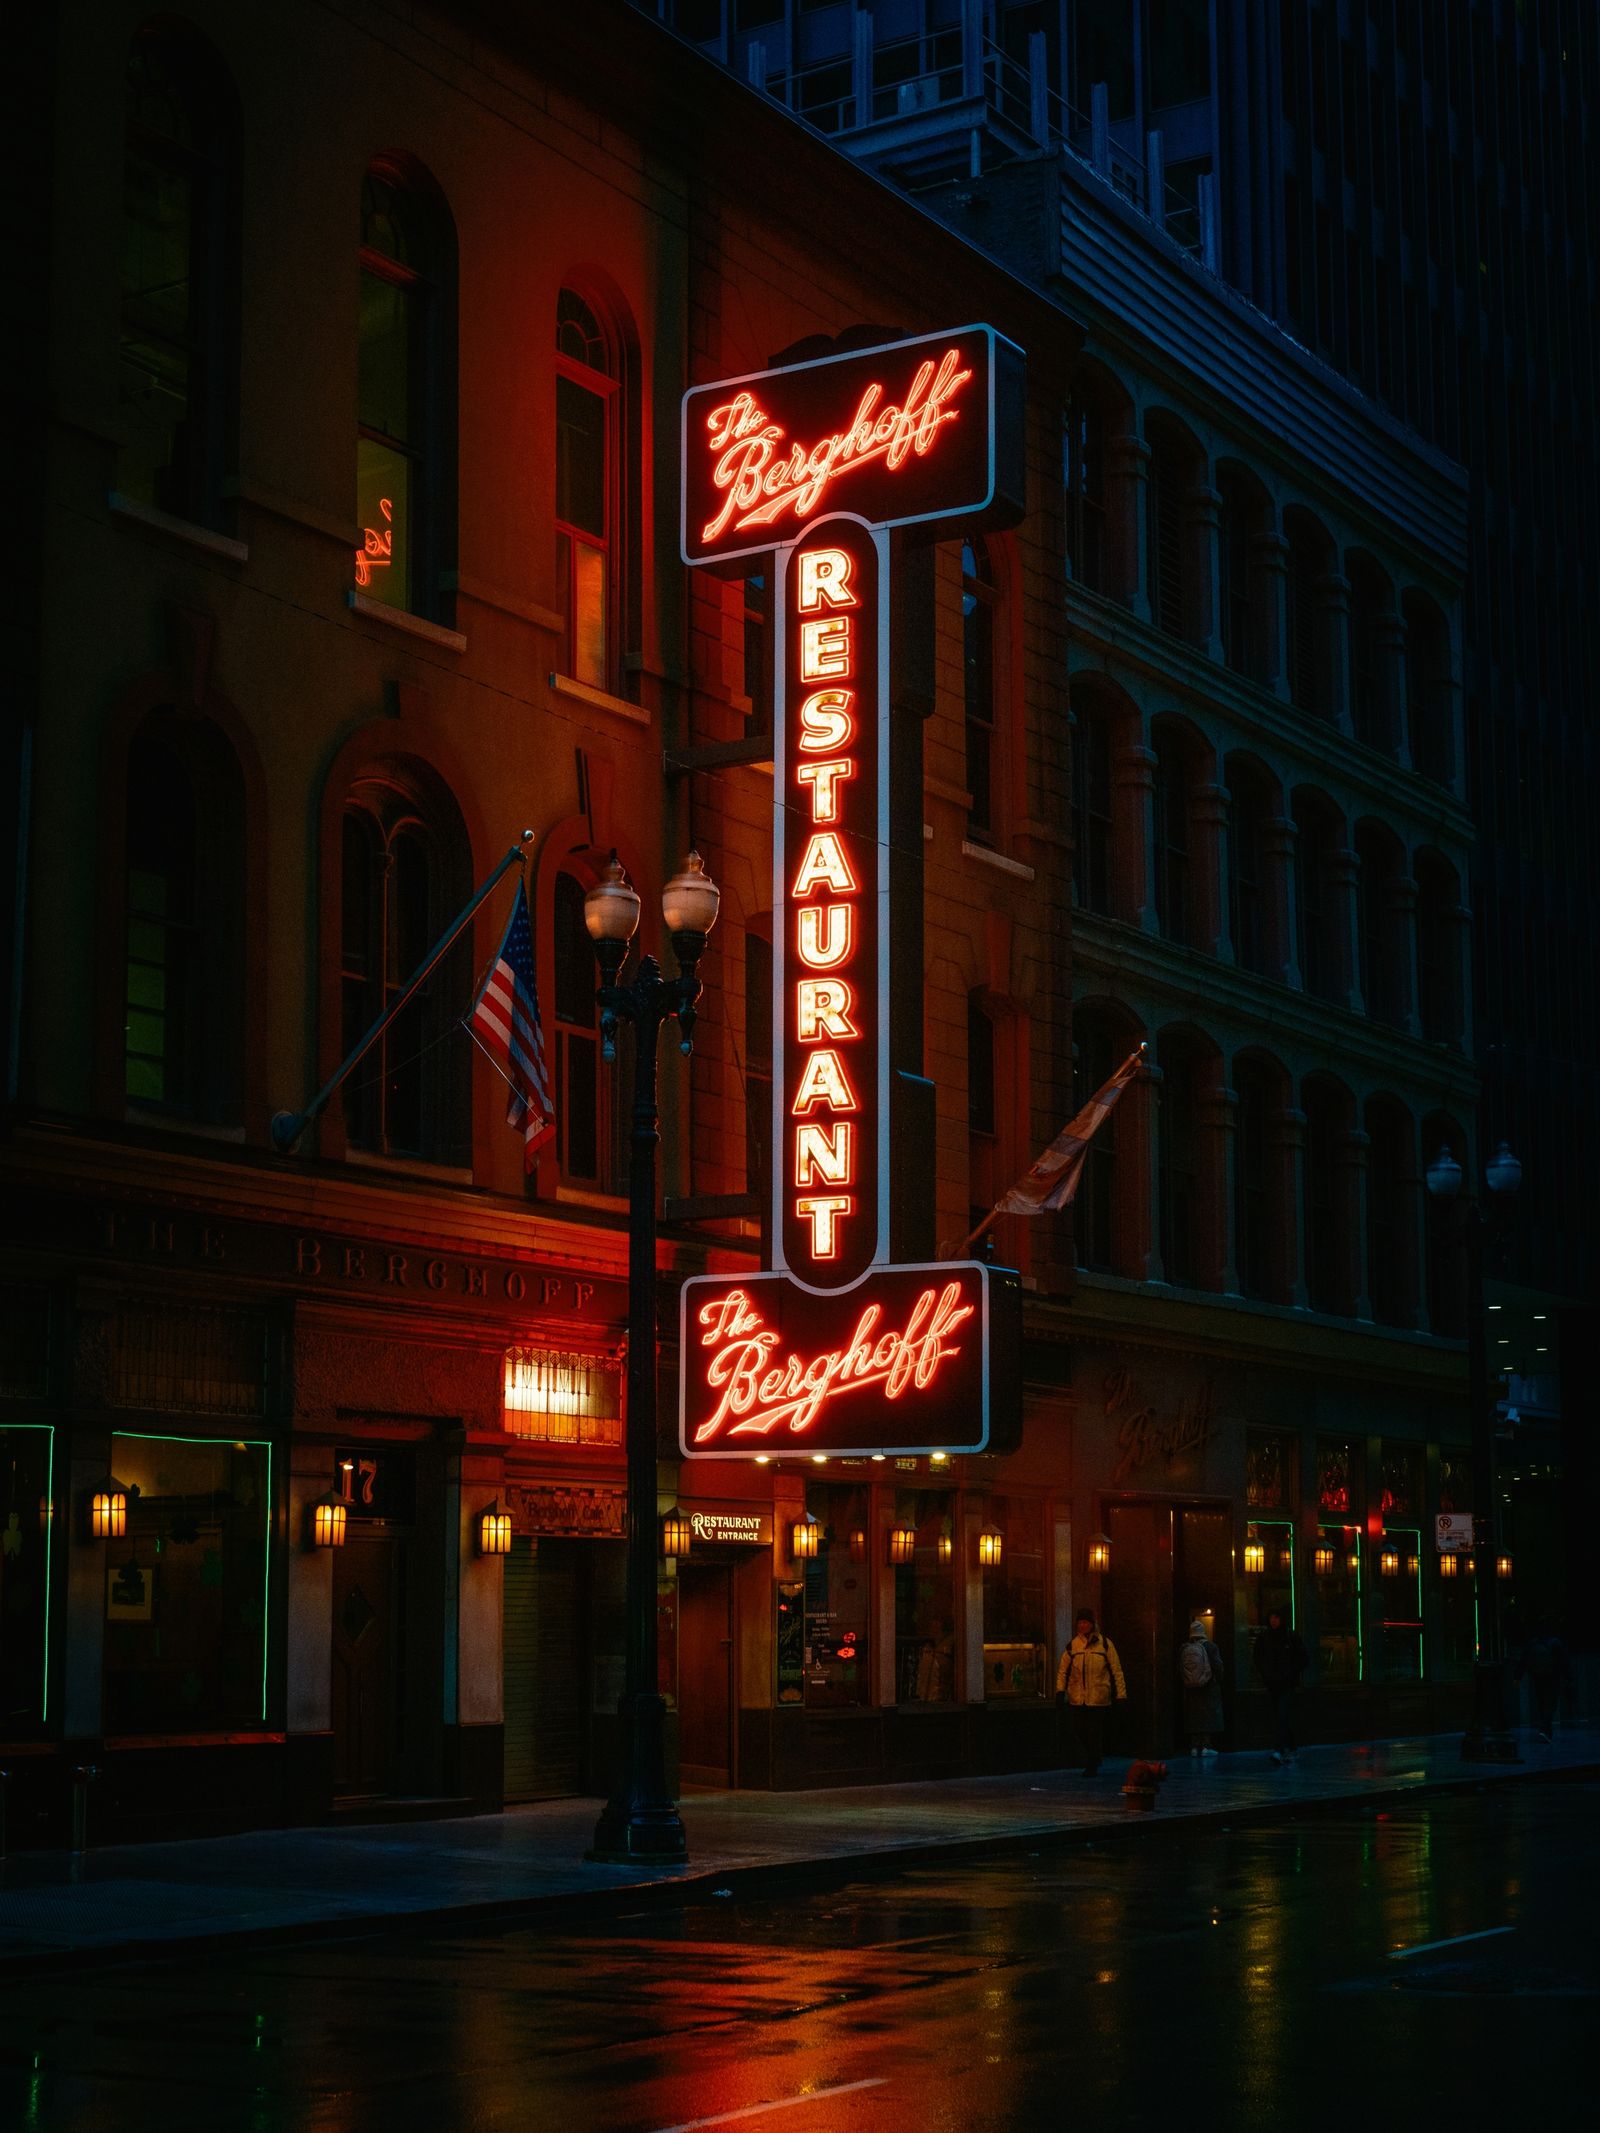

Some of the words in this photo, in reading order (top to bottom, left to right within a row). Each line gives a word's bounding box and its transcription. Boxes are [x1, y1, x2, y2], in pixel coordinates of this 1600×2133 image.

[702, 349, 972, 542] Berghoff
[707, 392, 768, 450] The
[792, 548, 860, 1261] RESTAURANT
[292, 1236, 595, 1311] BERGHOFF
[699, 1289, 763, 1346] The
[694, 1281, 974, 1442] Berghoff
[338, 1457, 377, 1504] 17
[717, 1531, 758, 1541] ENTRANCE
